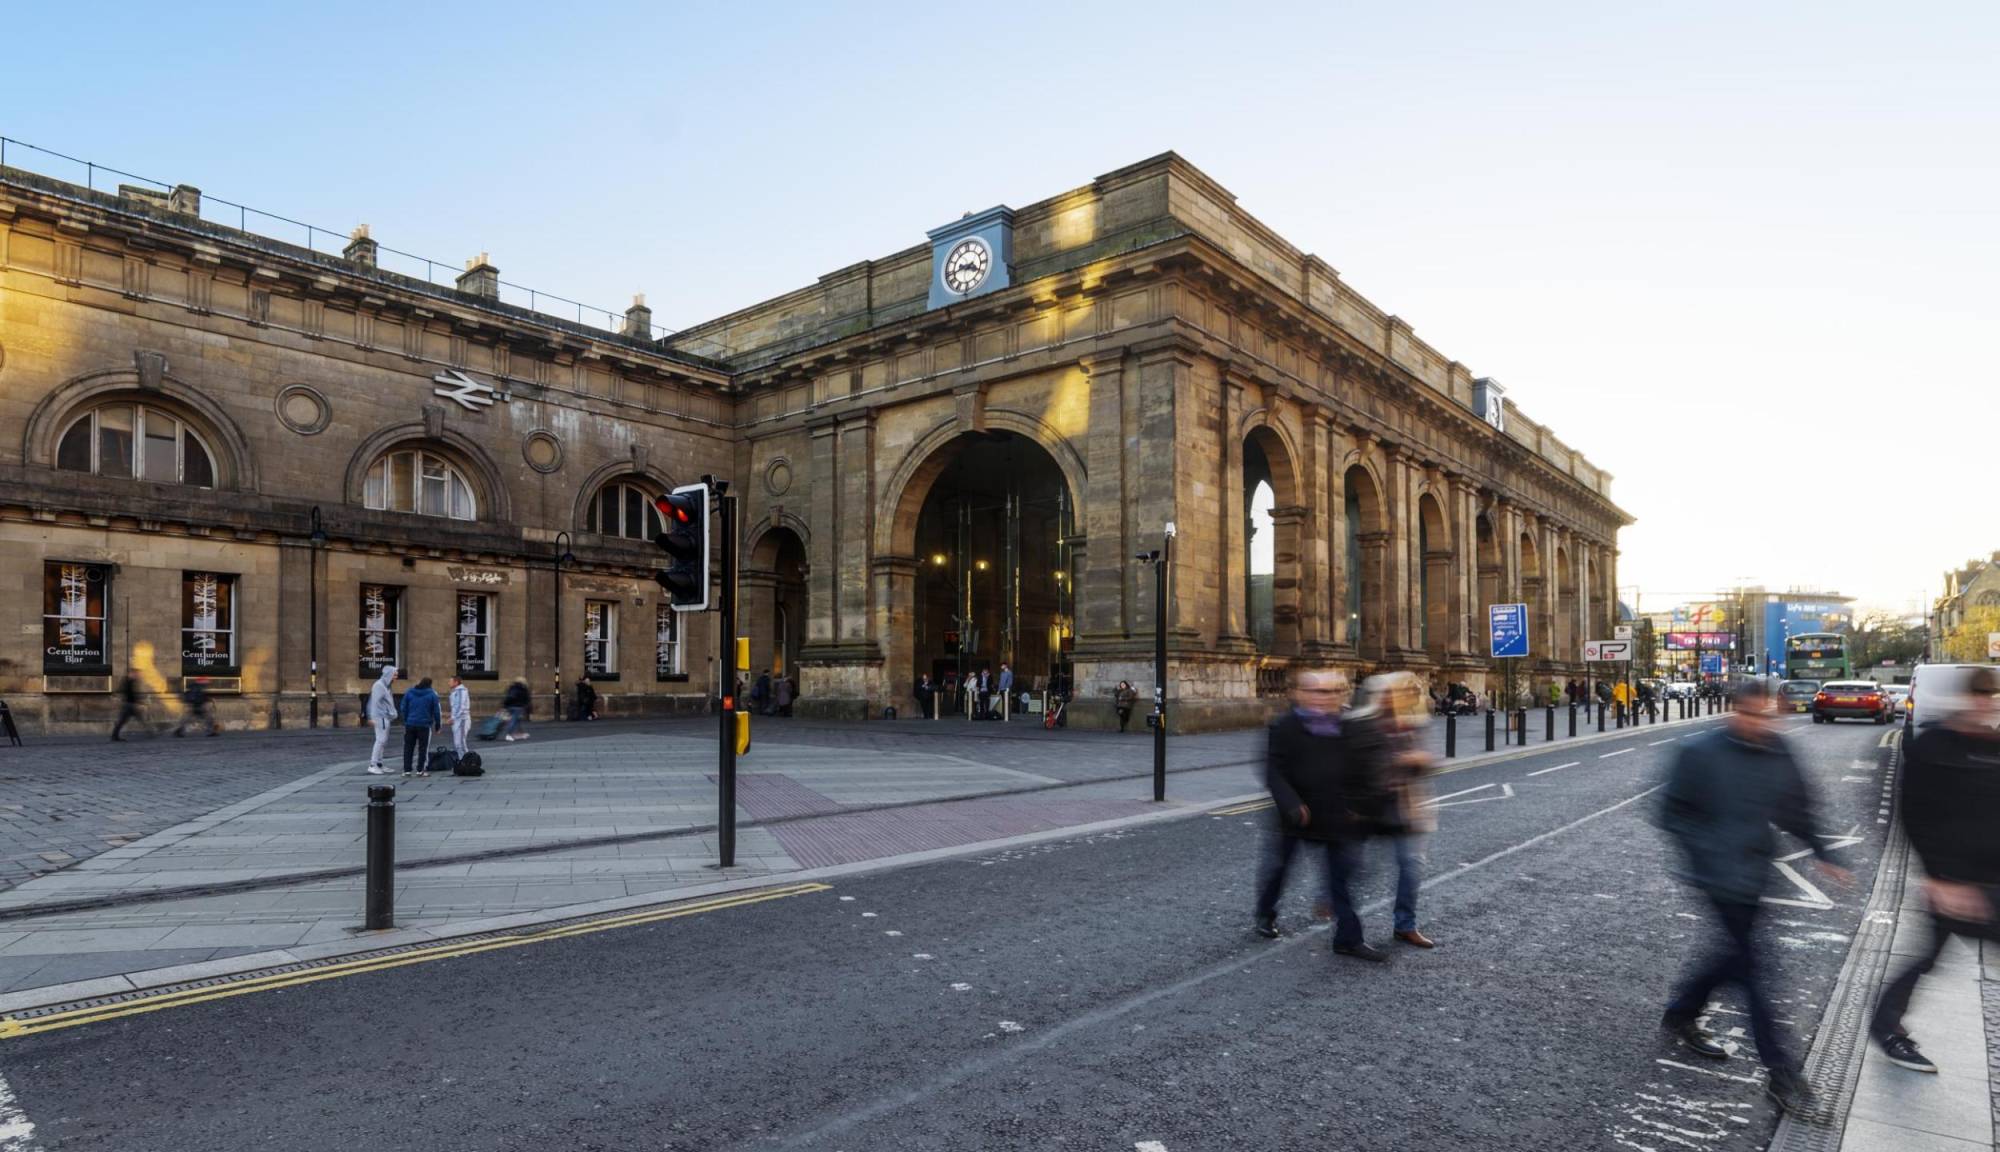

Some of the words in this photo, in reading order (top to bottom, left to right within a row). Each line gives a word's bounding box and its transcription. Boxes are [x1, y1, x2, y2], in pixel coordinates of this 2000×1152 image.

[47, 646, 100, 656] Centurion
[182, 650, 228, 659] Centurion
[64, 655, 84, 663] Bar
